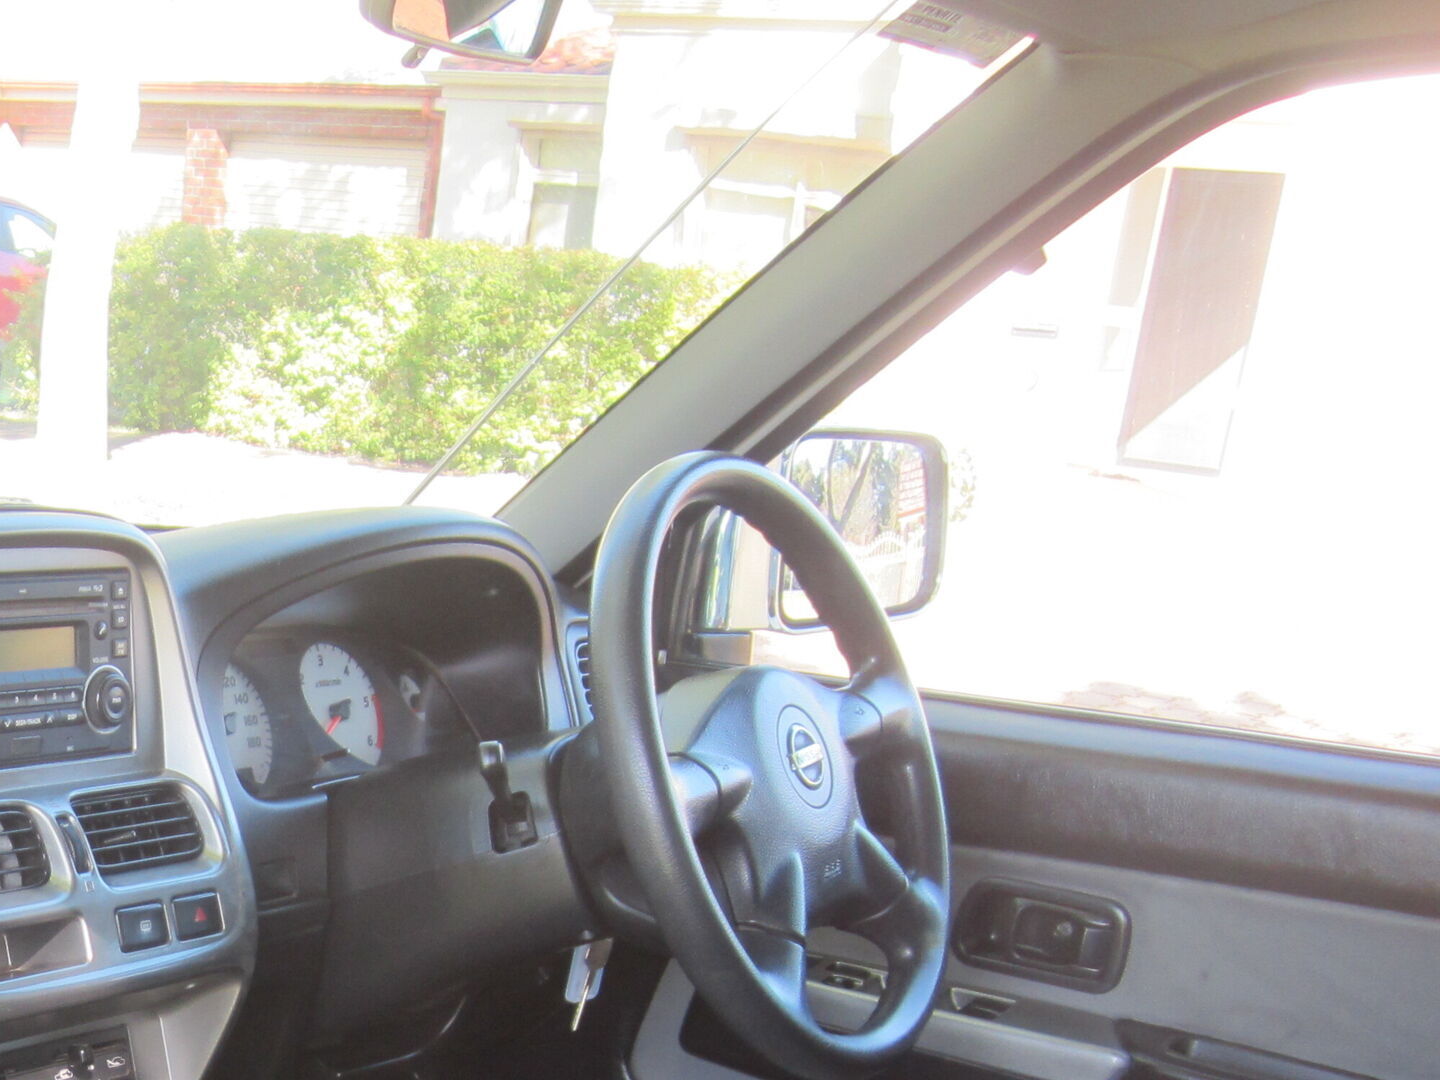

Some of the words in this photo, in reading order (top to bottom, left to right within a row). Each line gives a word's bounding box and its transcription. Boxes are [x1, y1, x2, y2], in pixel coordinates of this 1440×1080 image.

[318, 655, 324, 666] 3
[343, 665, 350, 676] 4
[234, 692, 249, 704] 140
[363, 696, 369, 708] 5
[367, 735, 373, 746] 6
